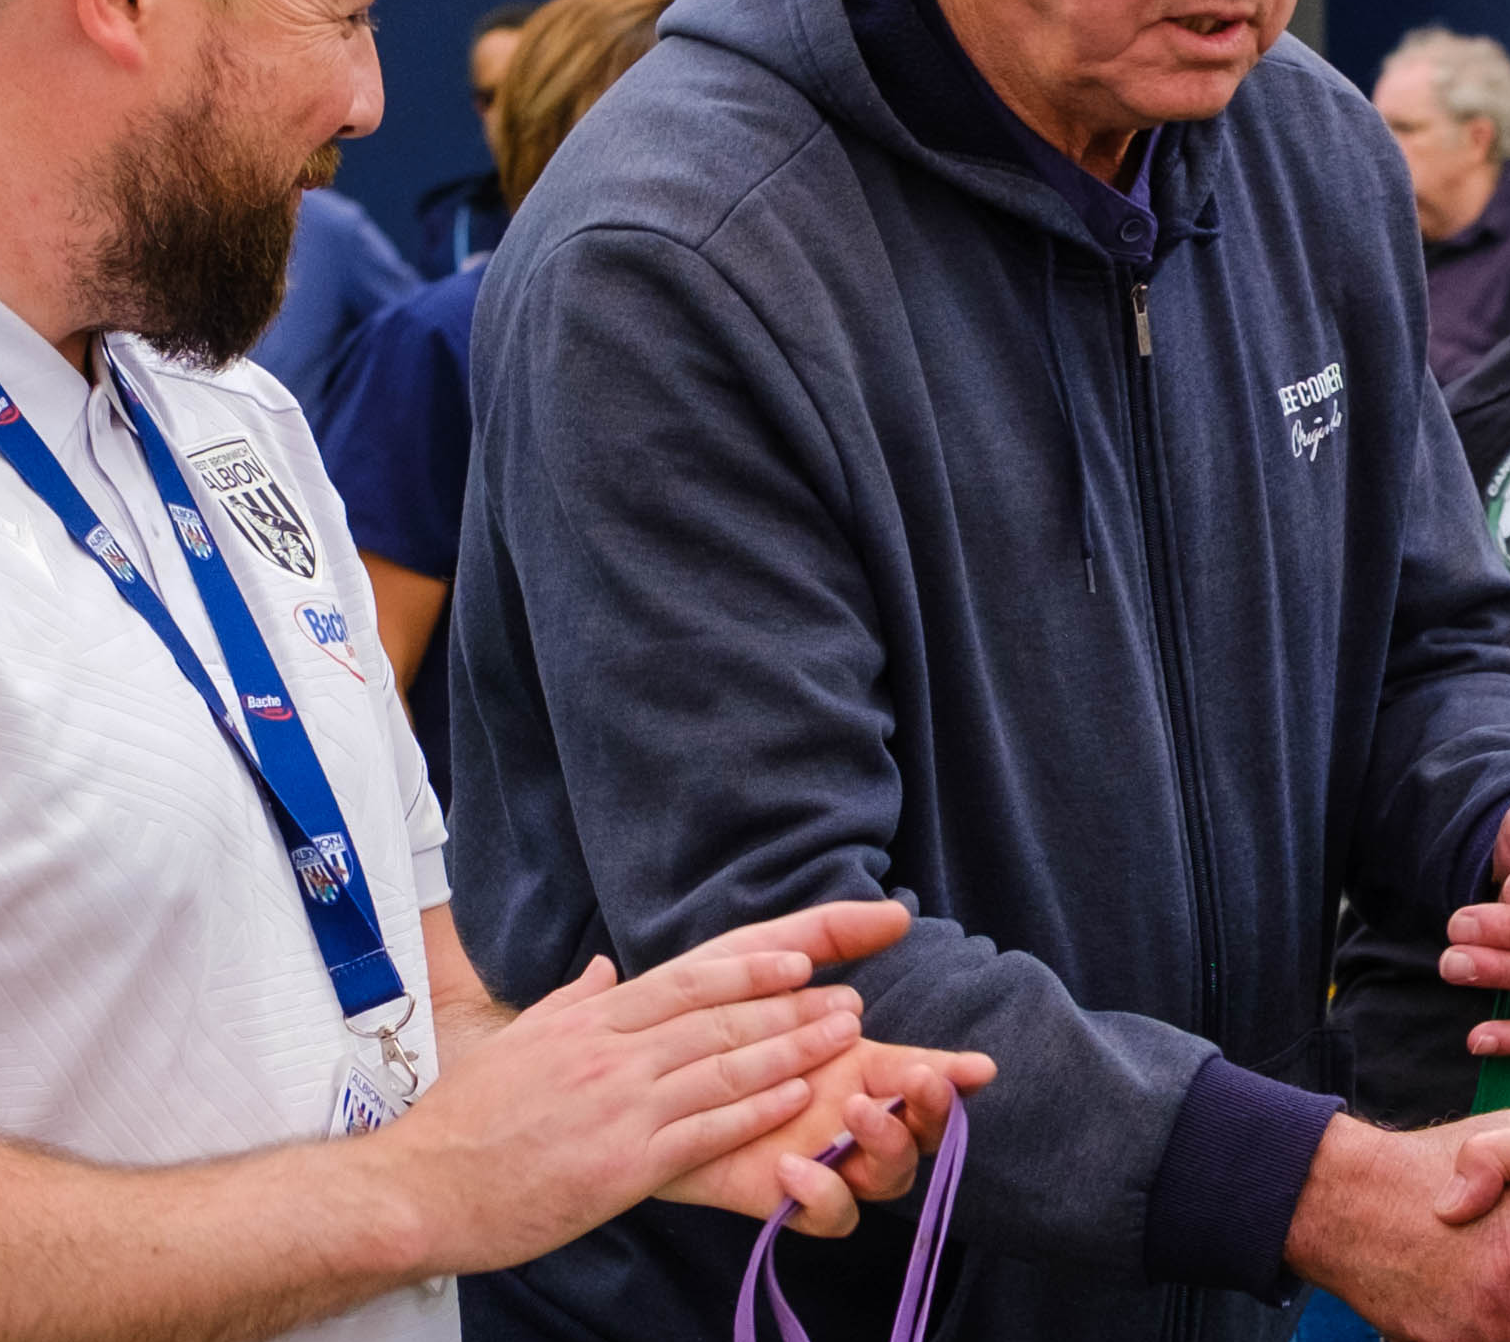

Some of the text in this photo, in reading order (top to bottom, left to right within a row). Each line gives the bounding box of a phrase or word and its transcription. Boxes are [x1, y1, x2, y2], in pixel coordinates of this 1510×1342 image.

[201, 456, 266, 493] ALBION
[303, 602, 350, 645] Bach
[352, 1073, 384, 1109] ALBION
